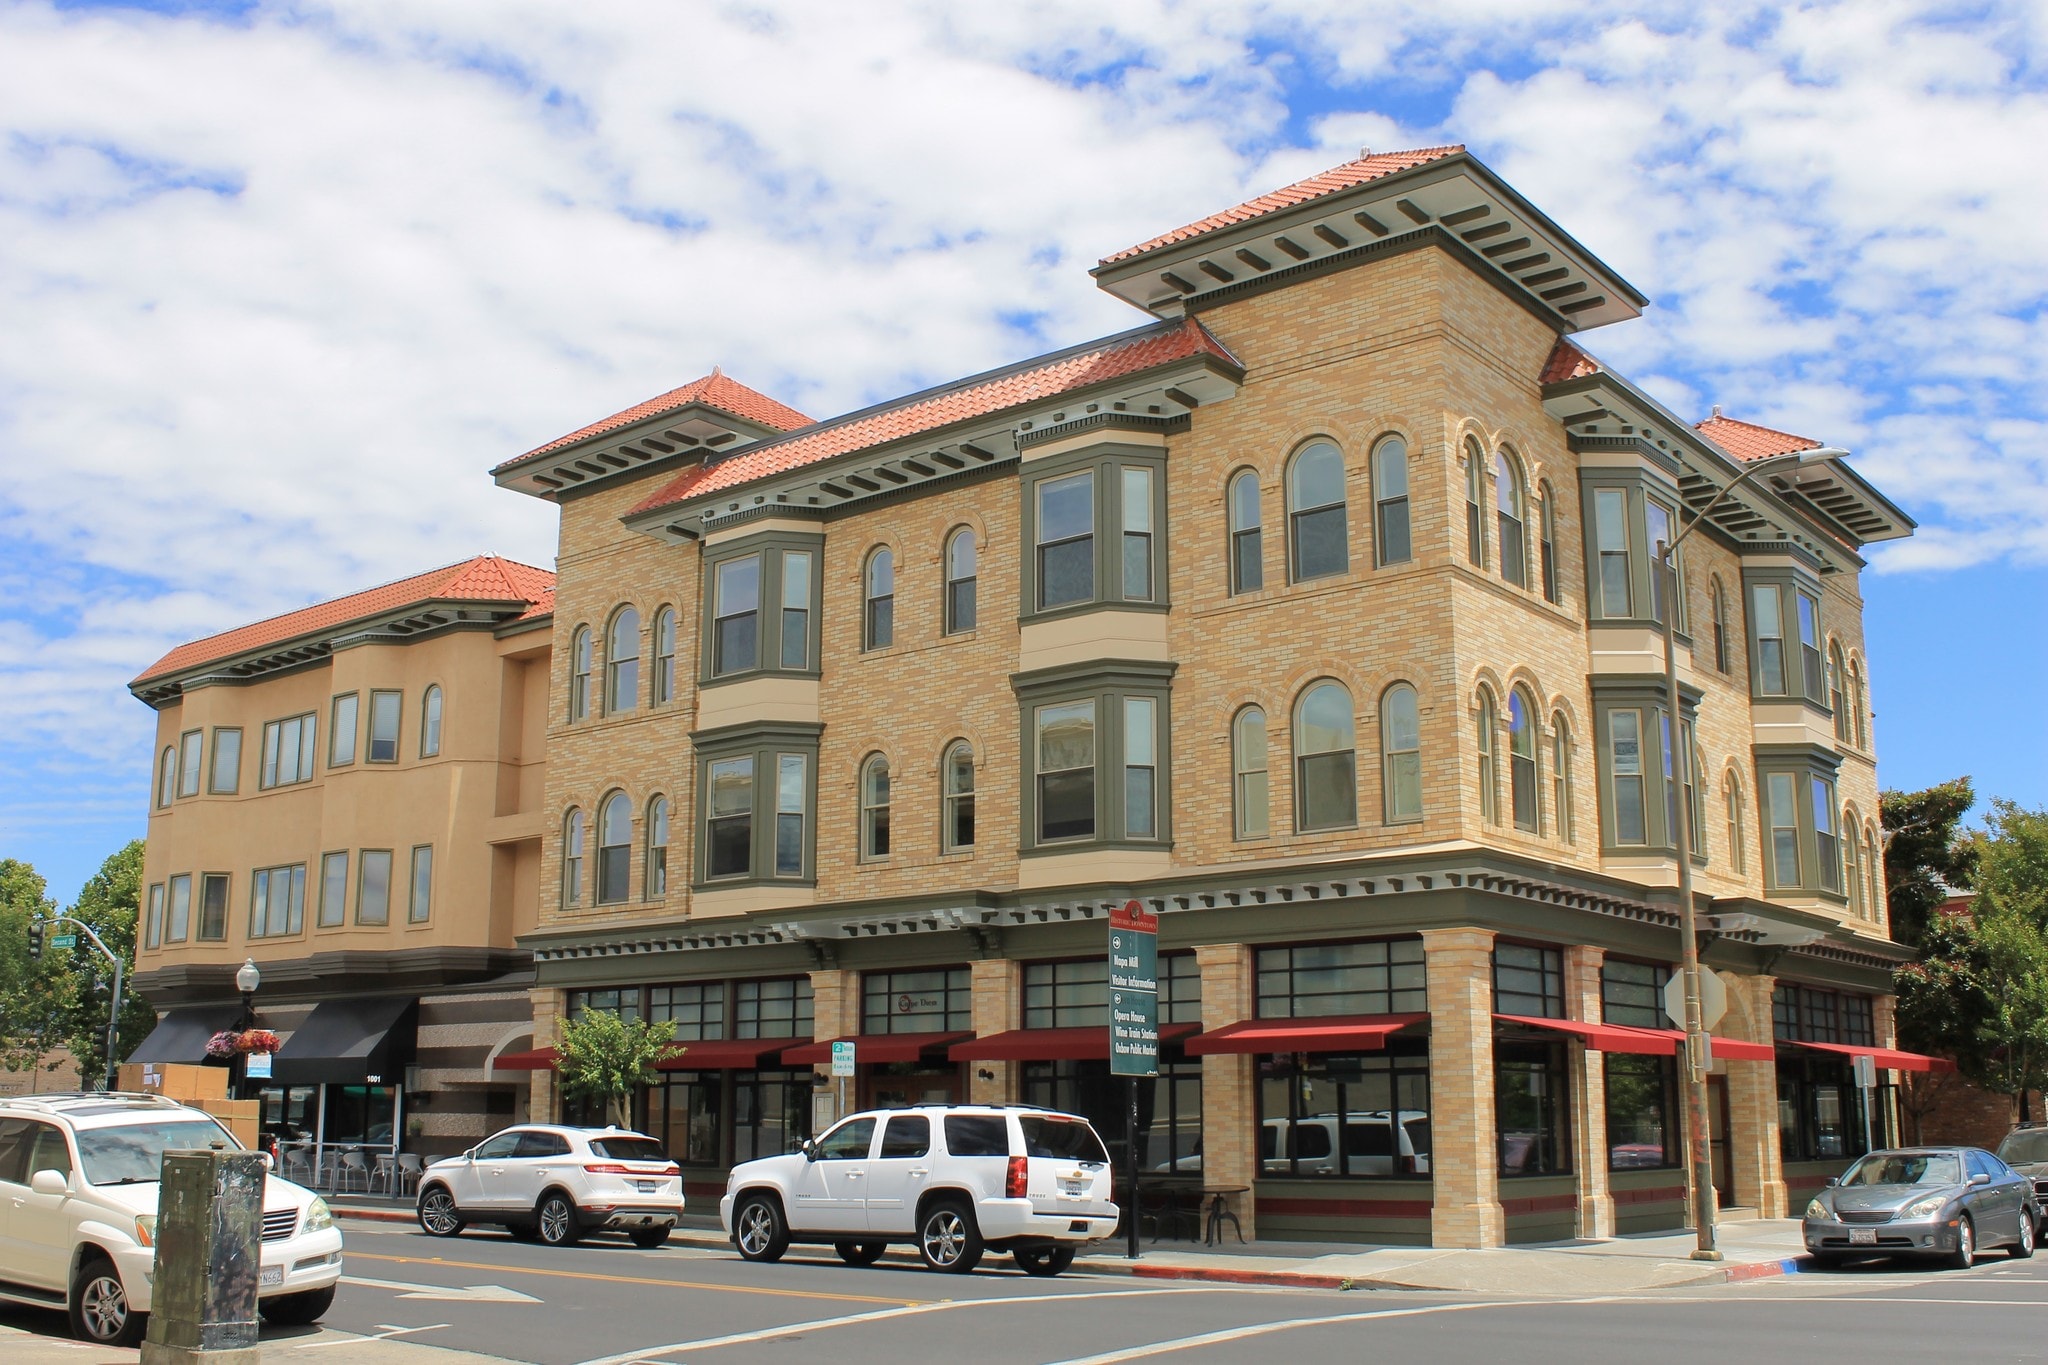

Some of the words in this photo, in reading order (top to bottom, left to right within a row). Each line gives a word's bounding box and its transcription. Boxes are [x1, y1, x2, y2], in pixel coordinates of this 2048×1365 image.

[1113, 954, 1128, 969] Napa
[1128, 955, 1139, 968] Mill
[1111, 973, 1128, 986] Visitor
[1128, 975, 1156, 989] Information
[1114, 1008, 1130, 1023] Opera
[1130, 1010, 1146, 1023] House
[1114, 1025, 1128, 1038] Wine
[1128, 1026, 1141, 1039] Train
[1141, 1027, 1158, 1040] Station
[1115, 1041, 1130, 1054] Oxbow
[1130, 1042, 1142, 1055] Public
[1142, 1044, 1157, 1056] Market
[366, 1074, 381, 1083] 1001
